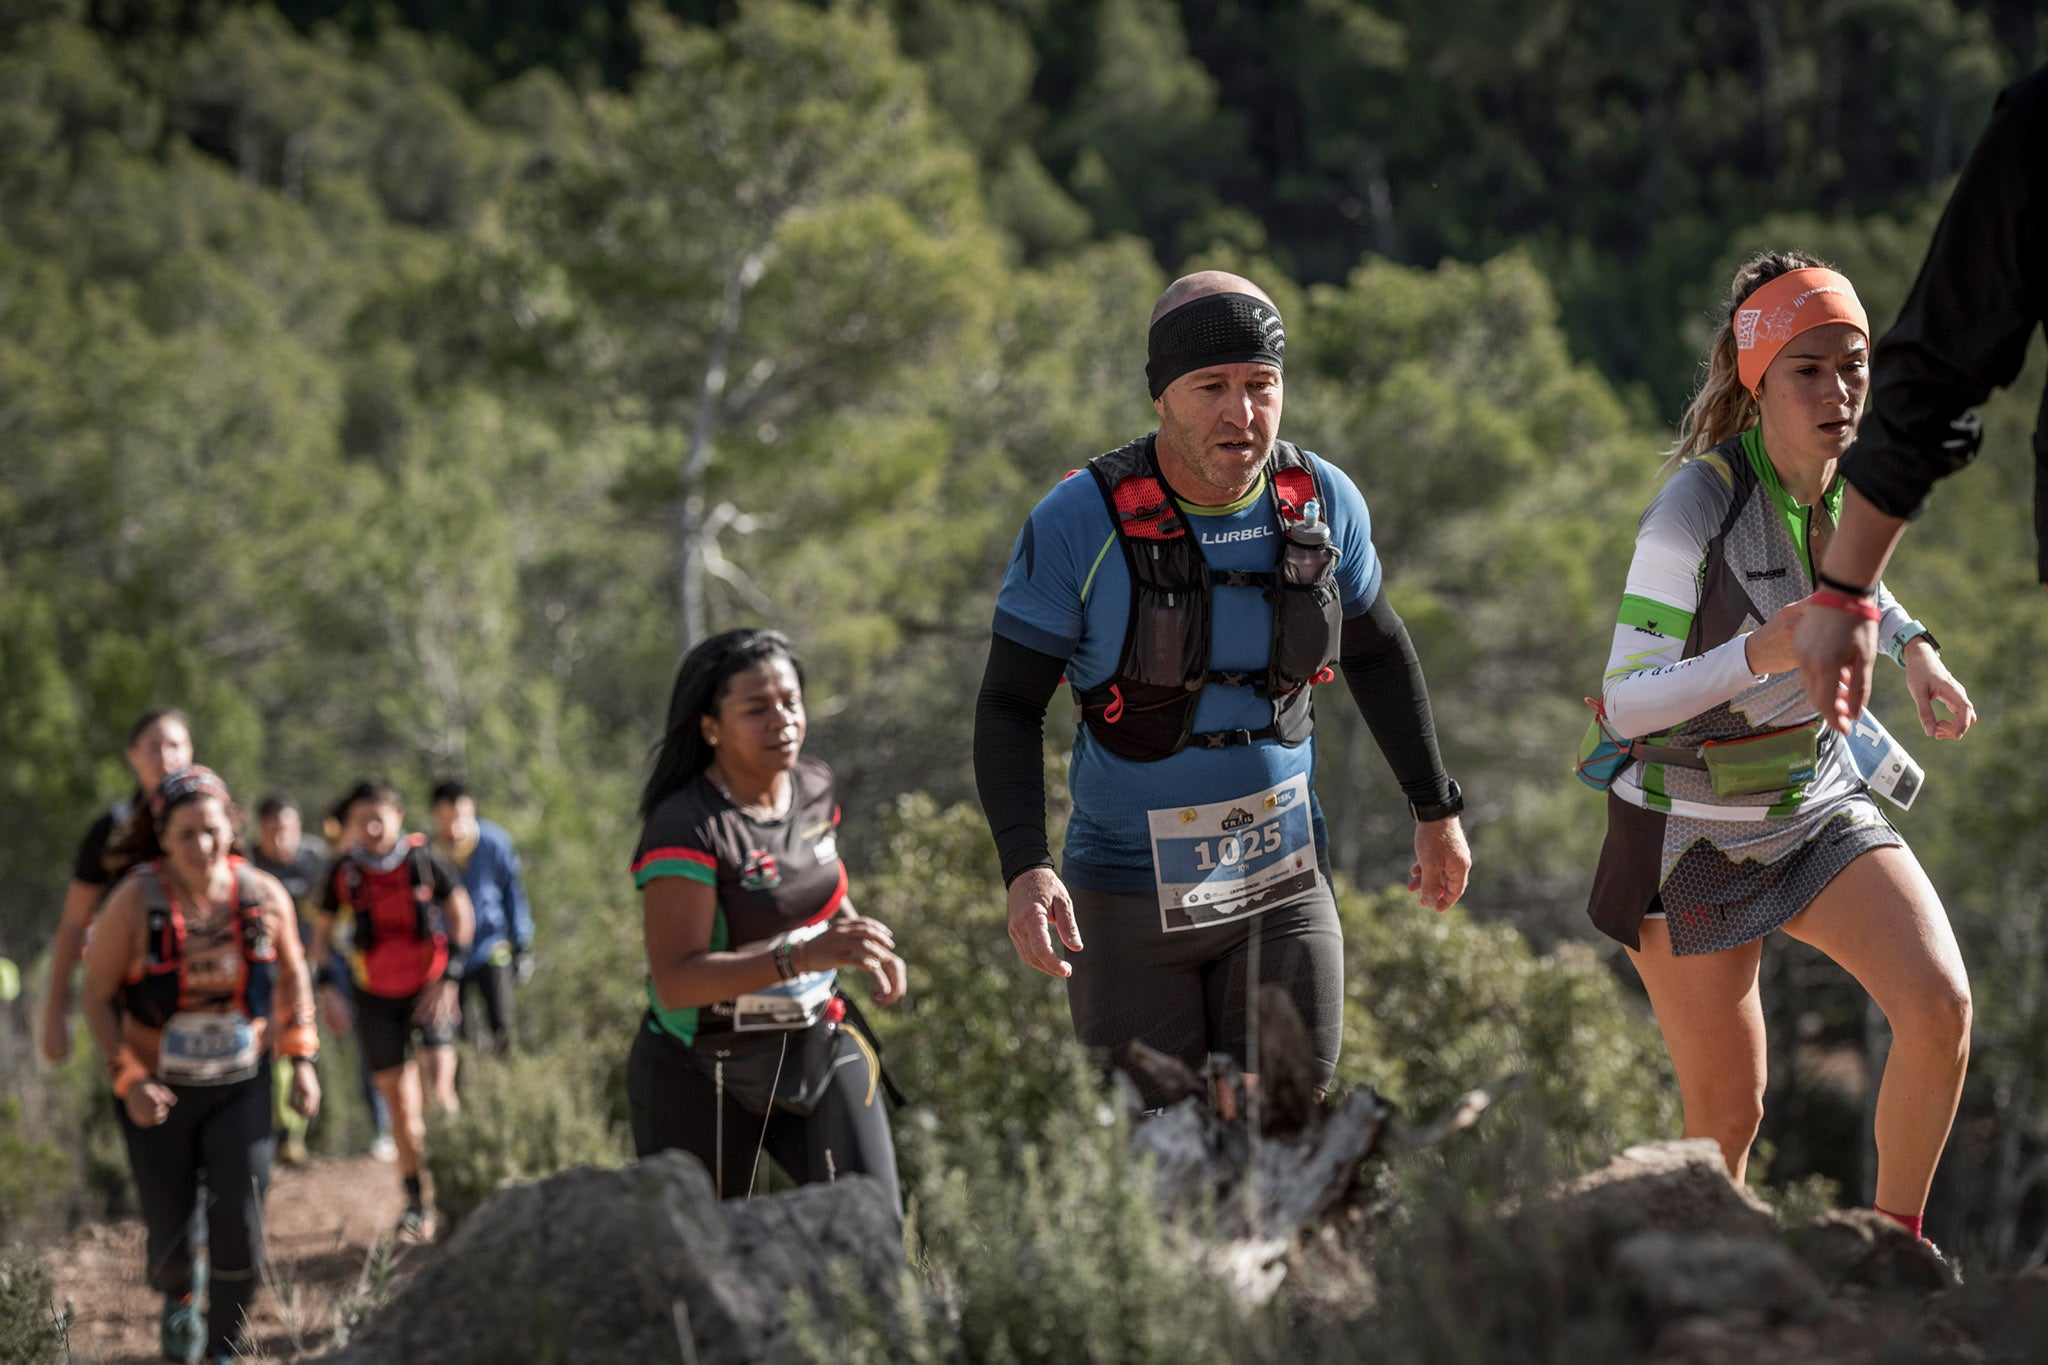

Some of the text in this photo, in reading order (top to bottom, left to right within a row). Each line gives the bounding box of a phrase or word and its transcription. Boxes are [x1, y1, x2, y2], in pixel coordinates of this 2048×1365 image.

[1201, 525, 1274, 545] LURBEL
[1223, 814, 1253, 829] TRAIL
[1194, 821, 1282, 871] 1025
